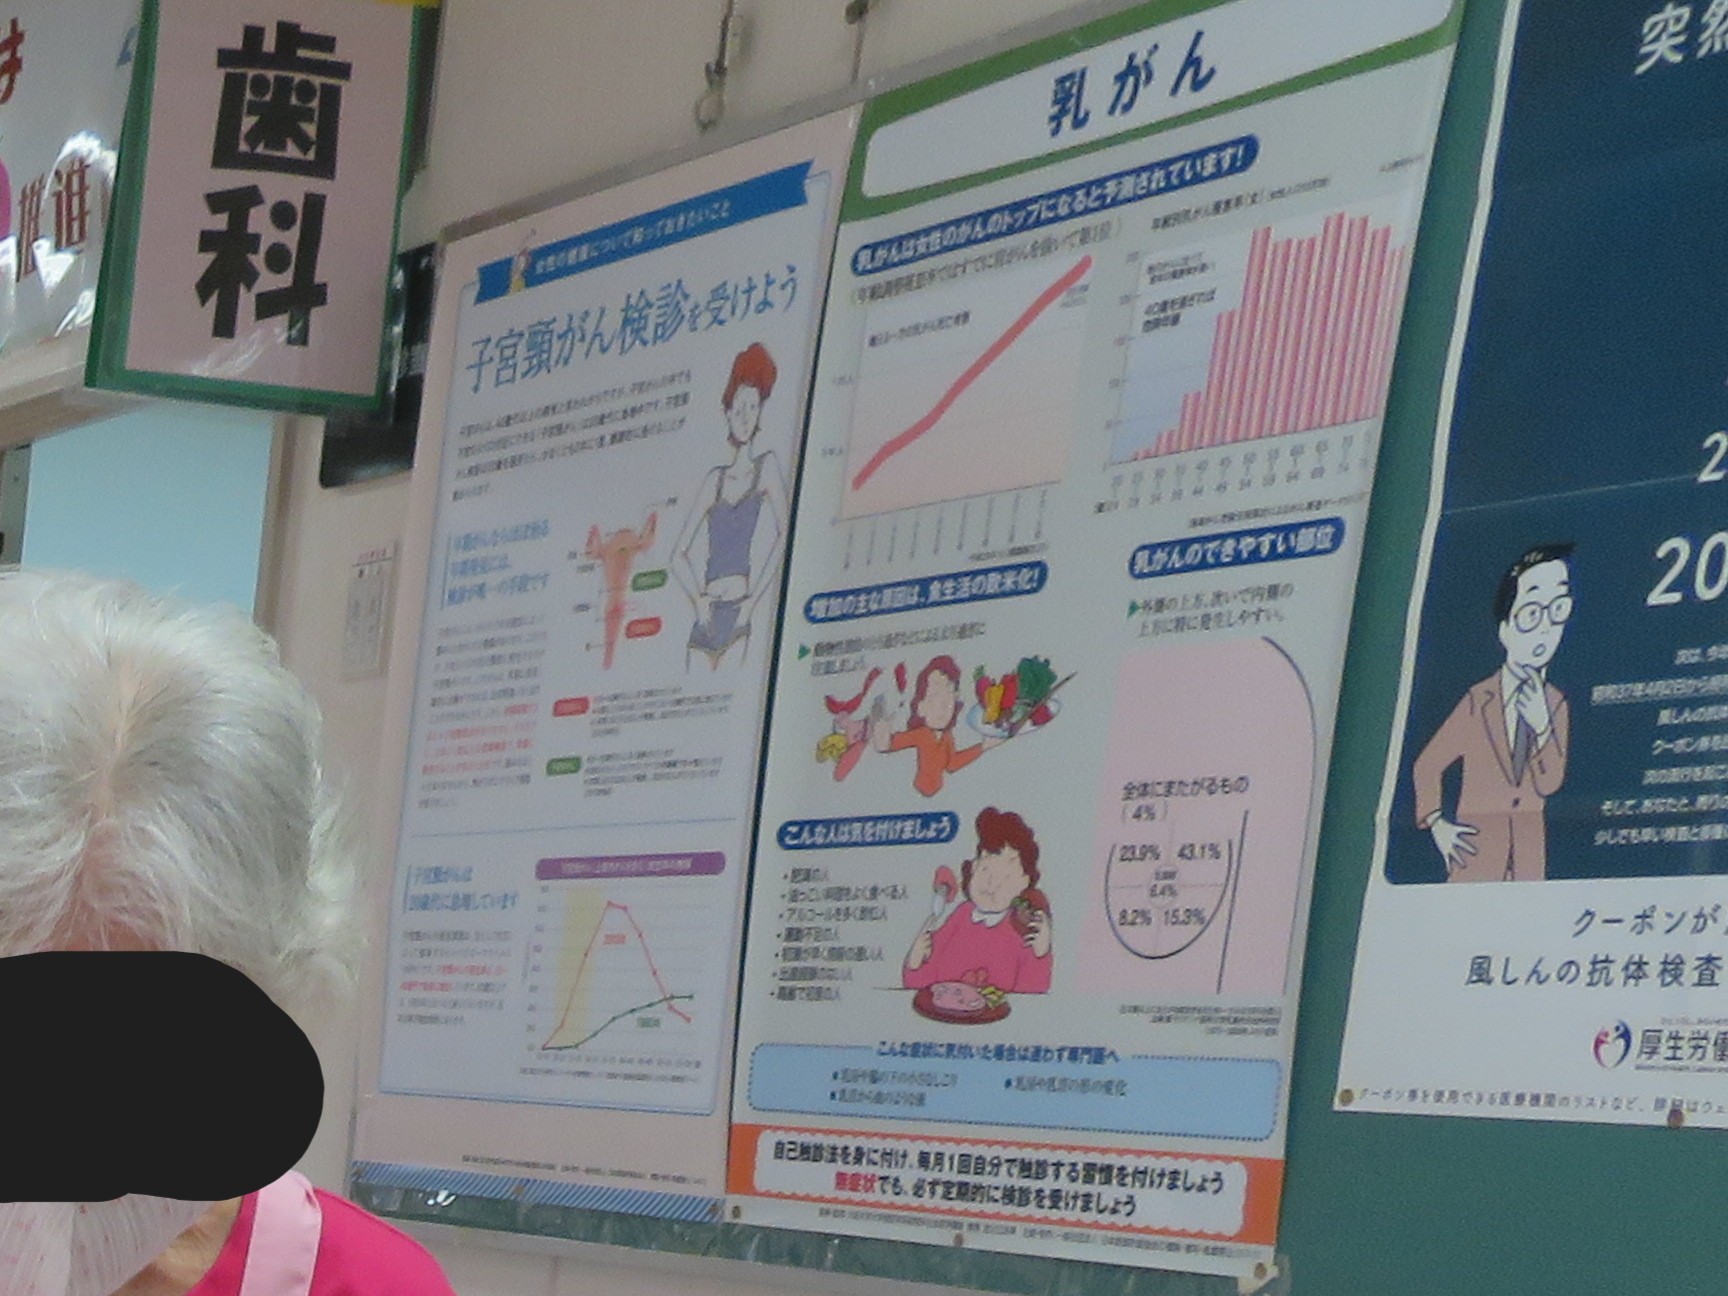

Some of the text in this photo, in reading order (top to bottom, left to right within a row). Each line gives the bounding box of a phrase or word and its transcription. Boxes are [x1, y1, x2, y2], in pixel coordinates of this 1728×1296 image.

[1047, 29, 1218, 138] 乳がん
[196, 20, 353, 347] 歯科
[465, 264, 800, 393] 子宮頸がん検診を受けよう
[1132, 525, 1335, 574] 乳がんのできやすい部位
[1120, 774, 1250, 801] 全体にまたがるもの
[782, 817, 954, 846] こんな人は気を付けましょう
[1177, 842, 1221, 860] 43.1%
[1118, 907, 1206, 926] 8.2% 15.3%
[1571, 902, 1728, 938] クーポンが
[1464, 951, 1724, 988] 風しんの抗体検査
[834, 1171, 1138, 1217] 無症状でも、必ず定期的に検診を受けましょう
